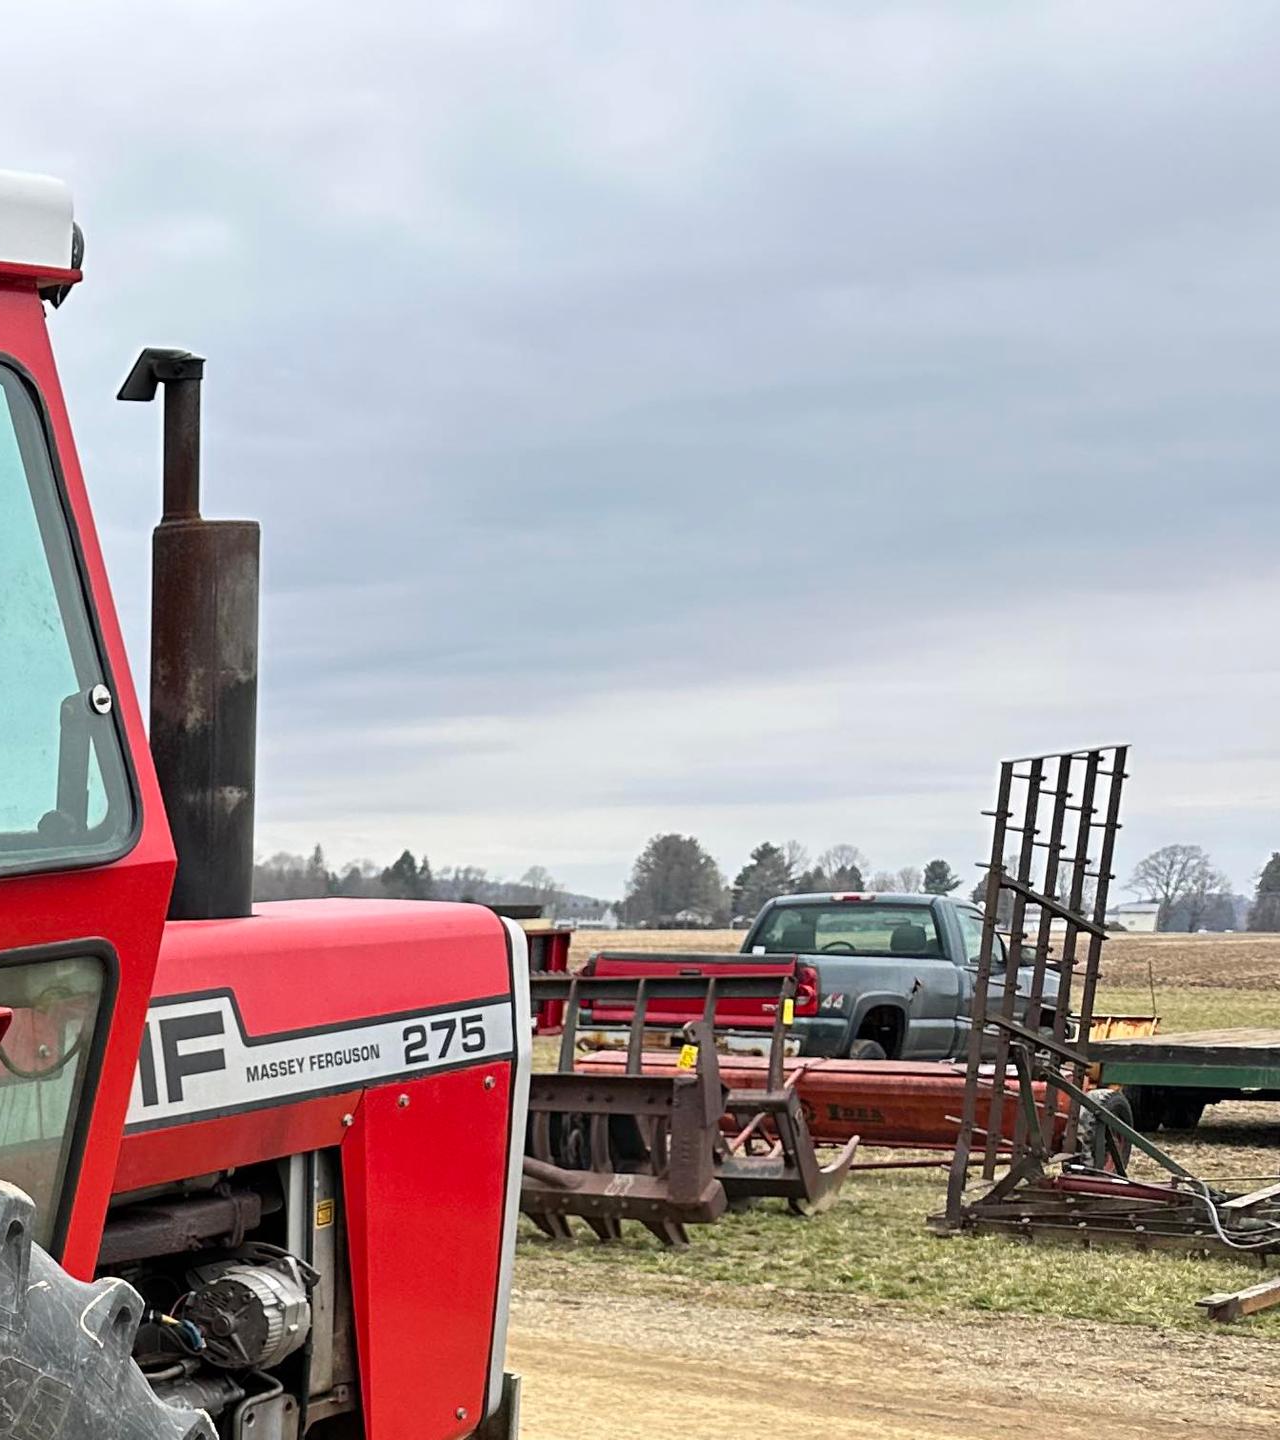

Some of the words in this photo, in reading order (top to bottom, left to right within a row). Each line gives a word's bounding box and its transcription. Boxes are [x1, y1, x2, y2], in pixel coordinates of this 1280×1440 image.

[246, 1057, 306, 1083] MASSEY
[309, 1043, 381, 1071] FERGUSON
[402, 1013, 486, 1065] 275
